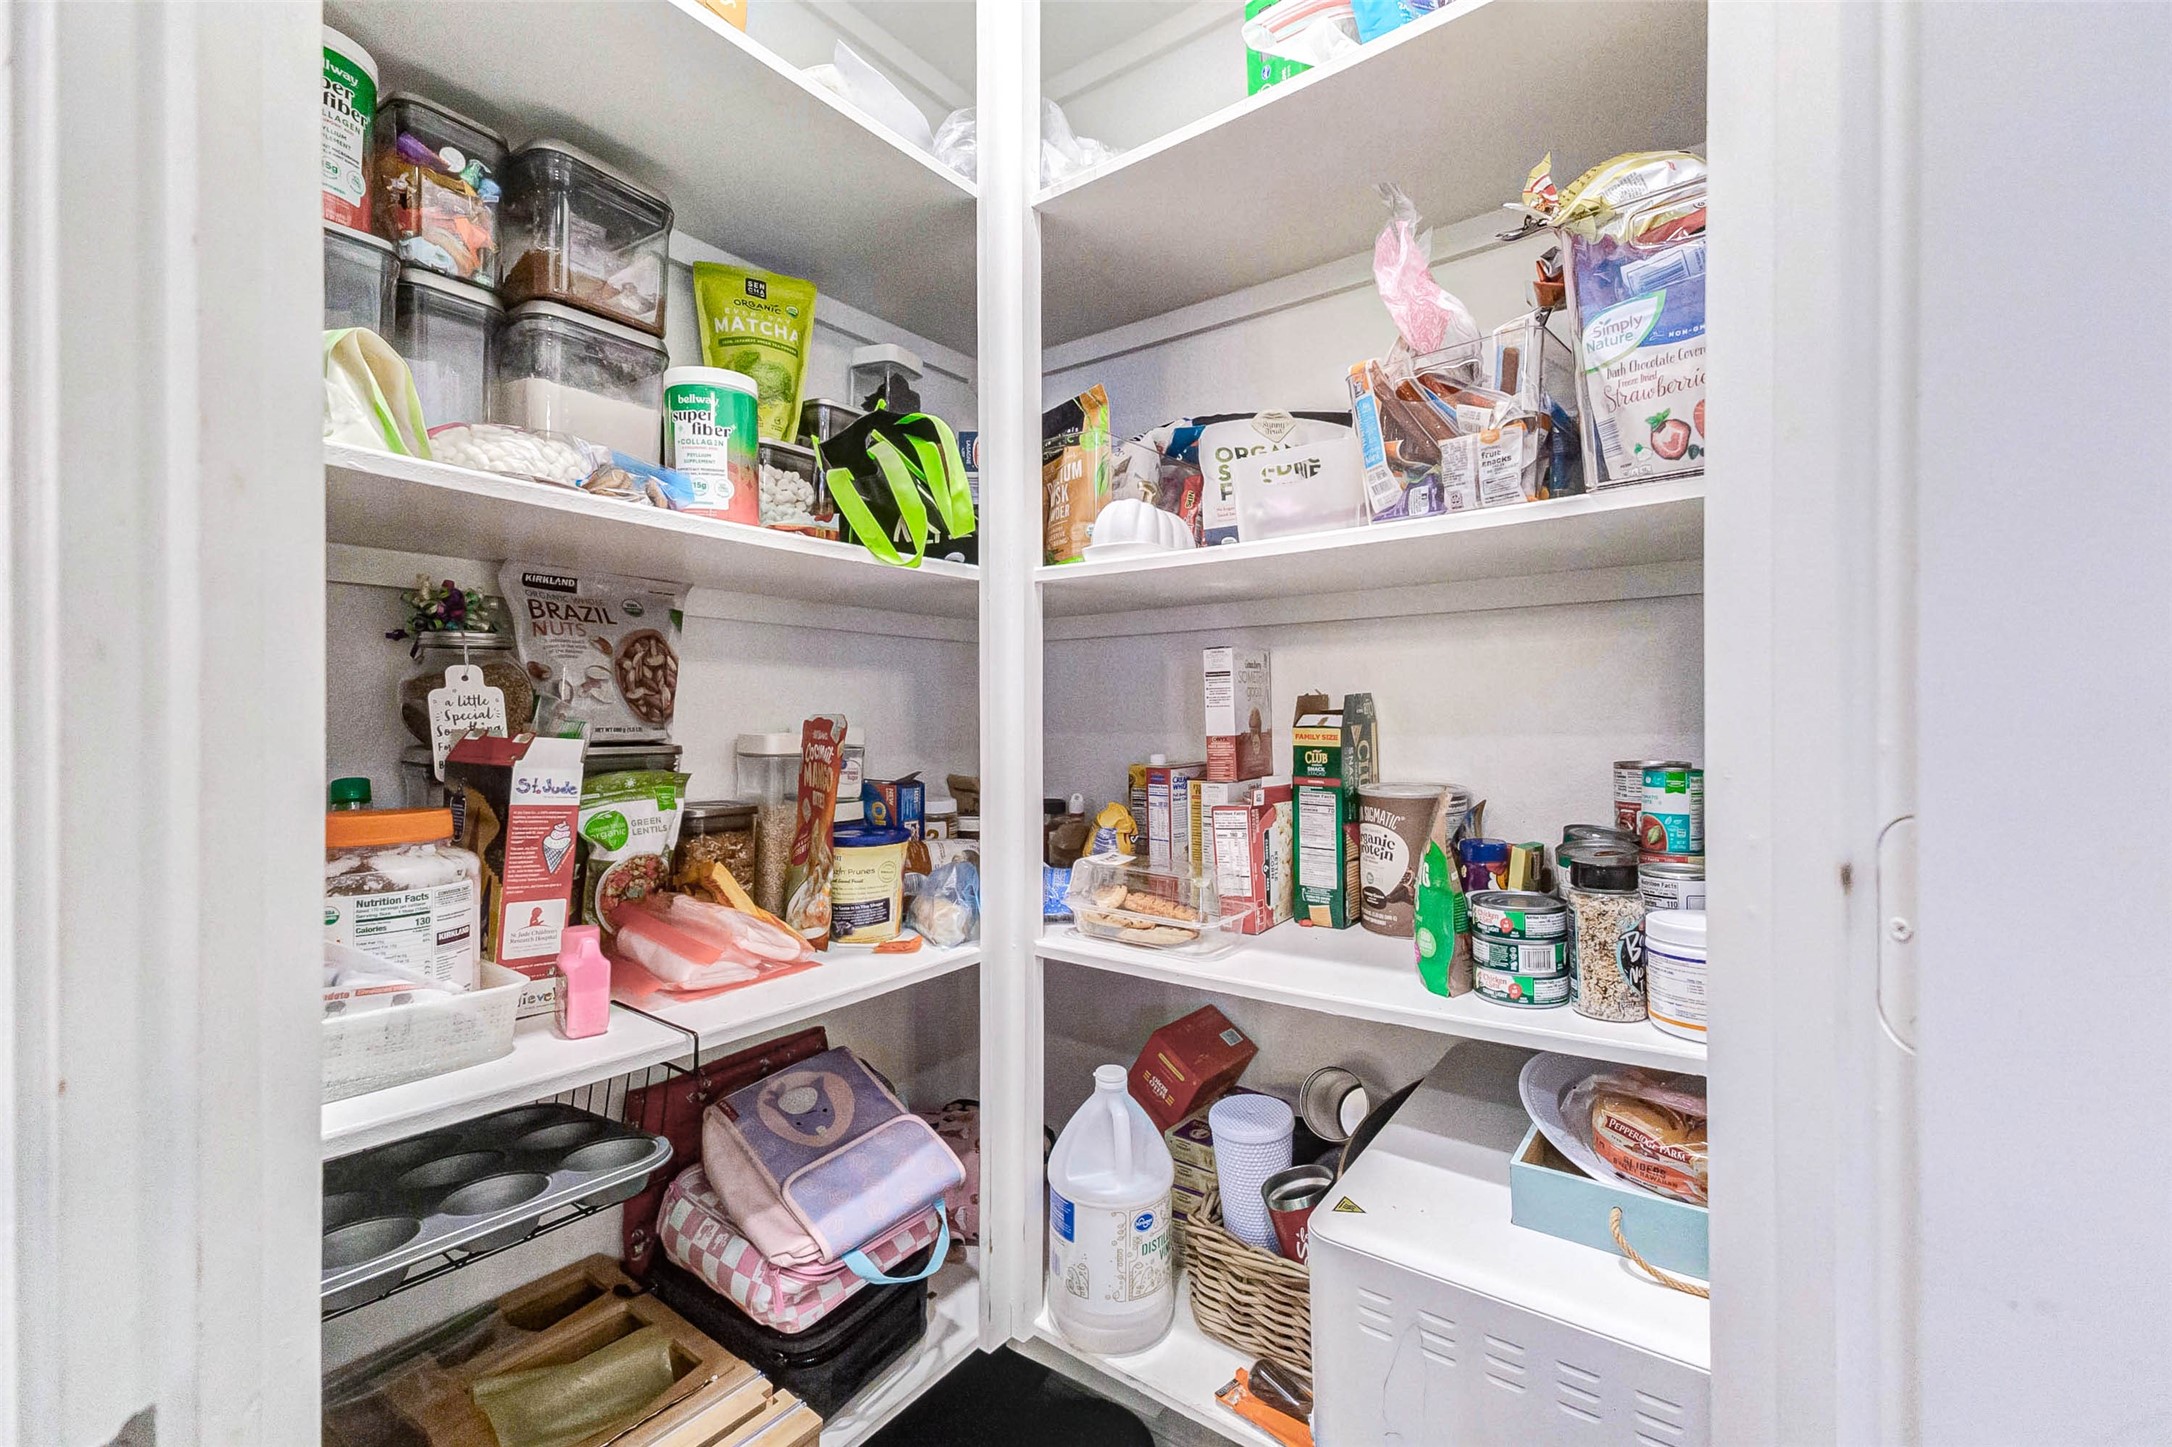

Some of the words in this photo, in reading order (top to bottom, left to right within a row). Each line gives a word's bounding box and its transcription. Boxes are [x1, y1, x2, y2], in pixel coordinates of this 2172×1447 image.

[323, 91, 368, 127] fiber
[747, 280, 766, 290] SEN
[747, 287, 765, 297] CHA
[733, 299, 782, 315] ORGANIC
[714, 317, 799, 343] MATCHA
[1593, 315, 1643, 339] Simply
[1668, 325, 1706, 338] NON-GM
[1586, 331, 1635, 353] Nature
[1607, 362, 1626, 380] Dark
[1629, 354, 1676, 373] Chocolate
[1603, 368, 1706, 414] Strawberrie
[678, 394, 719, 406] bellway
[673, 410, 712, 422] super
[692, 422, 731, 438] fiber
[1481, 450, 1501, 459] fruit
[1482, 456, 1512, 467] snacks
[693, 481, 707, 490] 15g
[525, 573, 575, 587] KIRKLAND
[528, 600, 618, 625] BRAZIL
[532, 622, 587, 637] NUTS
[458, 694, 489, 708] little
[445, 707, 494, 726] Special
[1305, 750, 1328, 764] CLUB
[516, 778, 541, 795] St.
[542, 778, 578, 795] Jude
[631, 817, 662, 827] GREEN
[1364, 806, 1401, 830] SIGMATIC
[590, 828, 626, 840] organic
[632, 825, 668, 836] LENTILS
[847, 868, 876, 876] Prunes
[356, 896, 402, 908] Nutrition
[404, 893, 430, 902] Facts
[415, 916, 431, 927] 130
[1477, 910, 1500, 920] Chicken
[356, 925, 387, 934] Calories
[438, 926, 470, 941] KIRKLAND
[510, 936, 534, 944] Research
[535, 935, 558, 943] Hospital
[1483, 973, 1507, 985] Chicken
[1608, 1118, 1659, 1150] PEPPERIDGE
[1659, 1144, 1686, 1162] FARM
